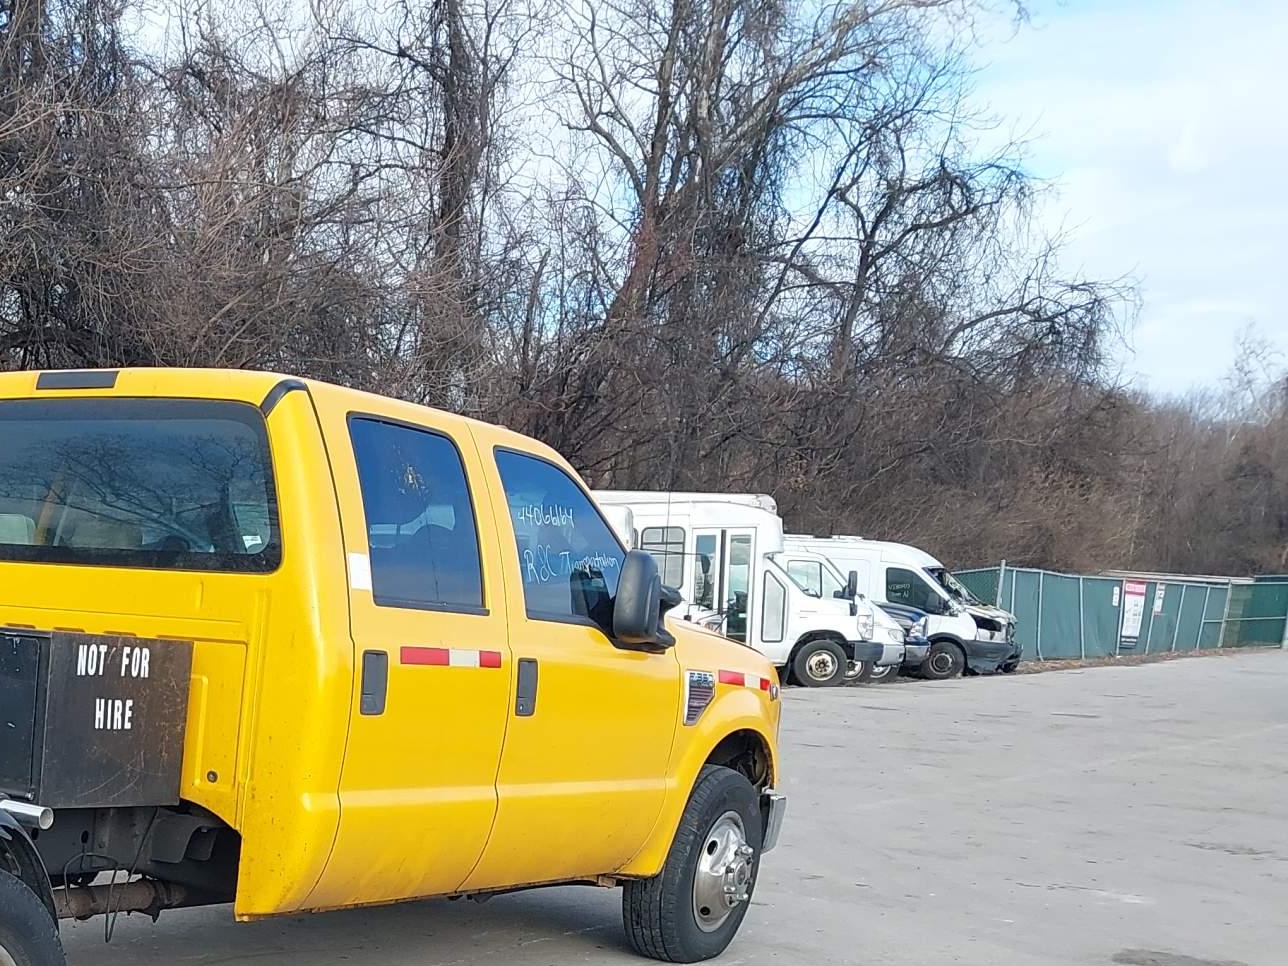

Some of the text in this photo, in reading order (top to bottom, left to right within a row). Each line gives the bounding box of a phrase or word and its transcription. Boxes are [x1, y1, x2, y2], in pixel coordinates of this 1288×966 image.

[517, 504, 575, 528] 44066164
[76, 644, 150, 678] NOT FOR
[94, 698, 133, 730] HIRE
